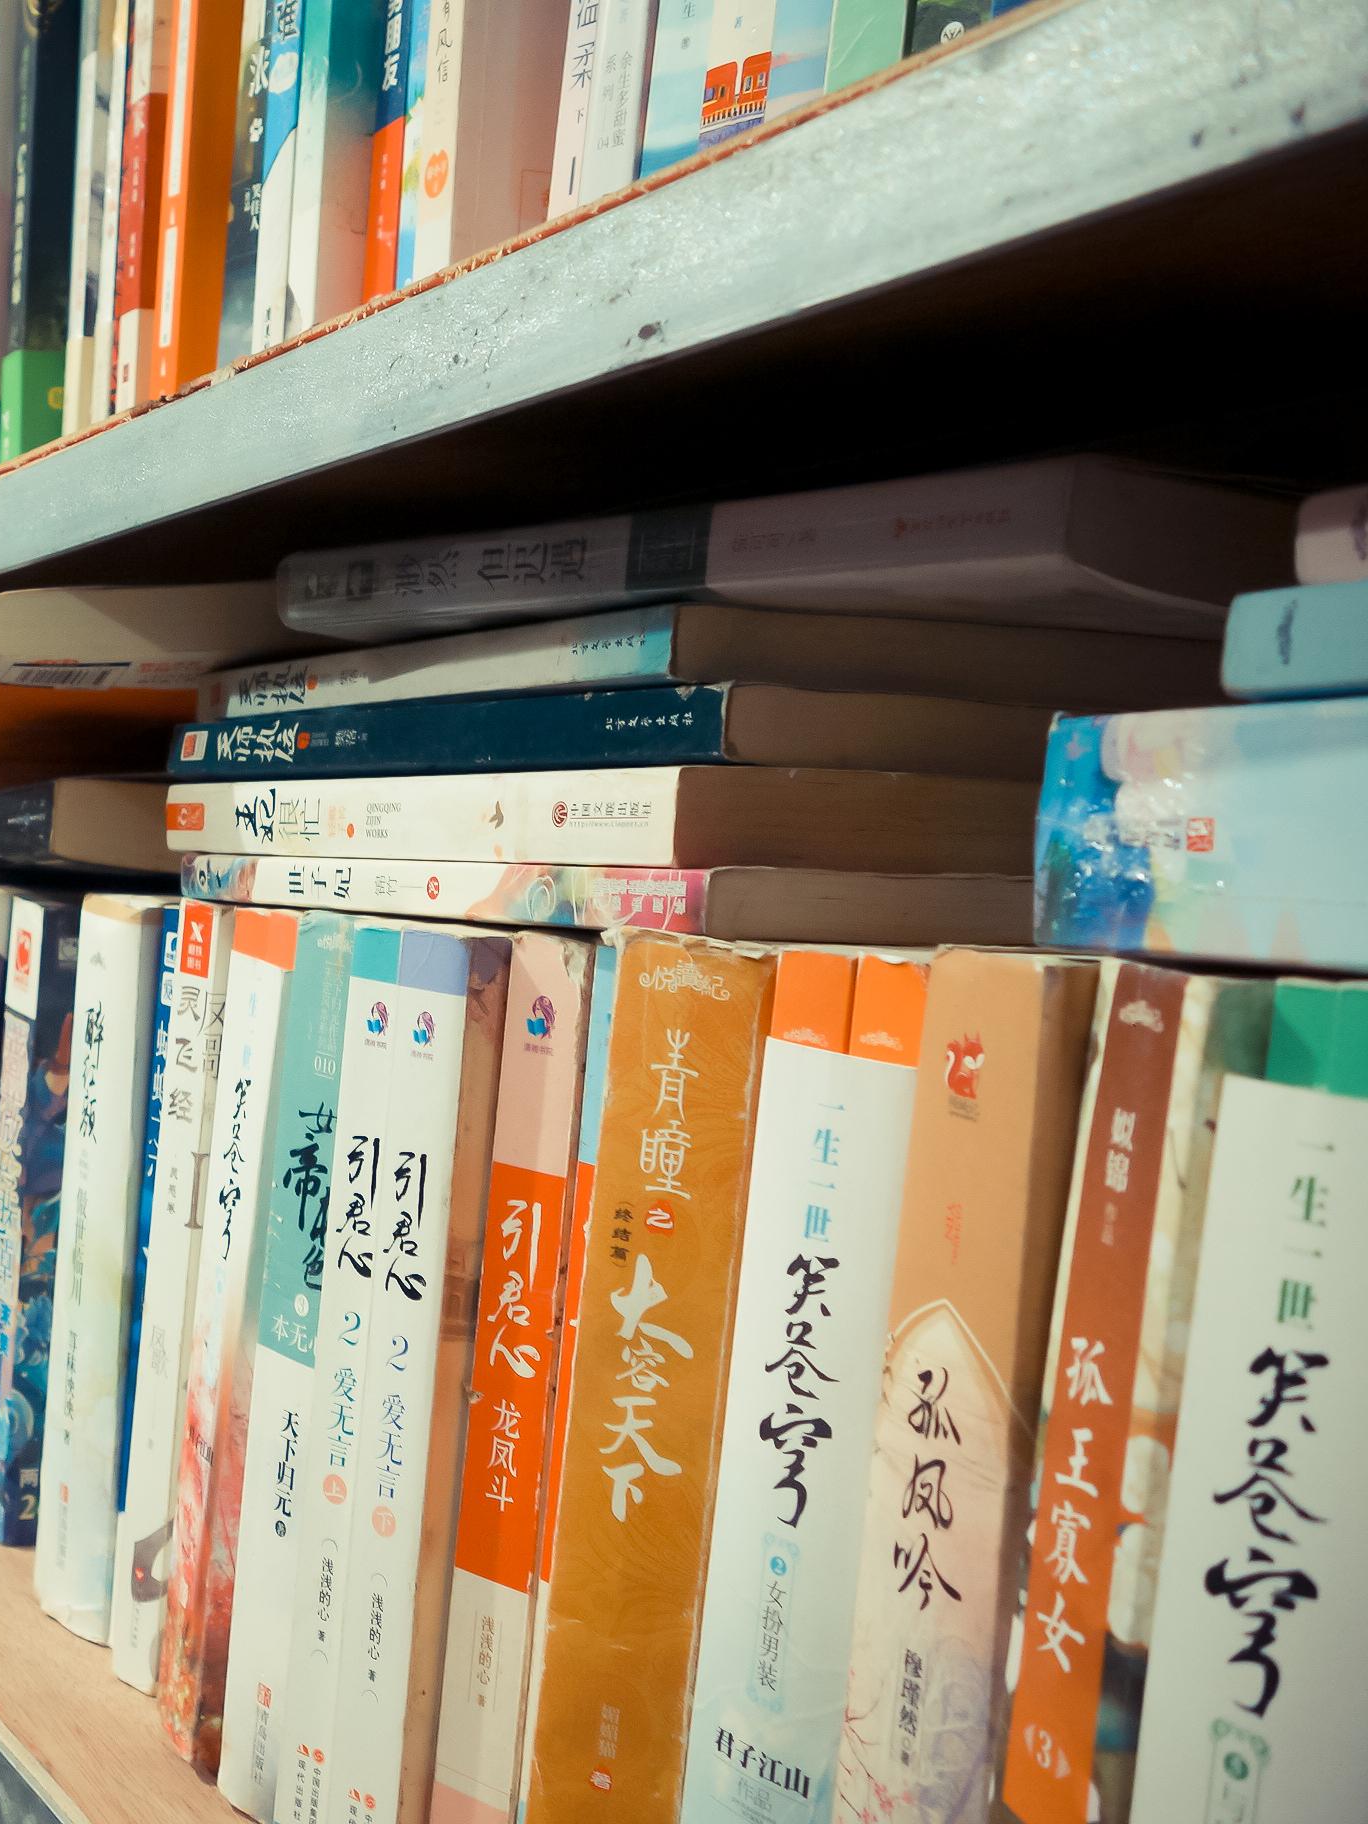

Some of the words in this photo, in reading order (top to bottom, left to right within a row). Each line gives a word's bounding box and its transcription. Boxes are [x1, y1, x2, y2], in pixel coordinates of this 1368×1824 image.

[239, 663, 310, 706] 天师执位
[217, 720, 299, 763] 天师执位
[235, 788, 320, 844] 王妃很忙
[365, 803, 402, 813] QINGQING
[365, 829, 389, 838] WORKS
[571, 801, 652, 816] 中国文联出版社
[289, 865, 352, 901] 世子妃
[169, 985, 200, 1123] 灵飞经
[314, 1055, 336, 1075] 010
[639, 1028, 699, 1200] 青瞳
[218, 1078, 253, 1260] 笑苍穹
[336, 1135, 380, 1278] 引君心
[802, 1103, 845, 1243] 一生一世
[383, 1152, 427, 1301] 引君心
[1277, 1140, 1337, 1331] 一生一世
[338, 1311, 361, 1347] 2
[488, 1200, 543, 1378] 引君心
[386, 1335, 409, 1372] 2
[600, 1253, 694, 1523] 大容天下
[759, 1252, 841, 1528] 笑苍穹
[273, 1409, 299, 1518] 天下归元
[328, 1367, 358, 1467] 爱无言
[376, 1393, 407, 1500] 爱无言
[485, 1397, 524, 1513] 龙凤斗
[891, 1365, 962, 1611] 孤凤吟
[1036, 1337, 1112, 1674] 孤王寡女
[1204, 1346, 1331, 1719] 笑苍穹
[317, 1557, 334, 1622] 浅浅的心
[367, 1593, 384, 1661] 浅浅的心
[755, 1580, 787, 1692] 女扮男装
[477, 1615, 496, 1685] 浅浅的心
[715, 1726, 811, 1799] 君子江山
